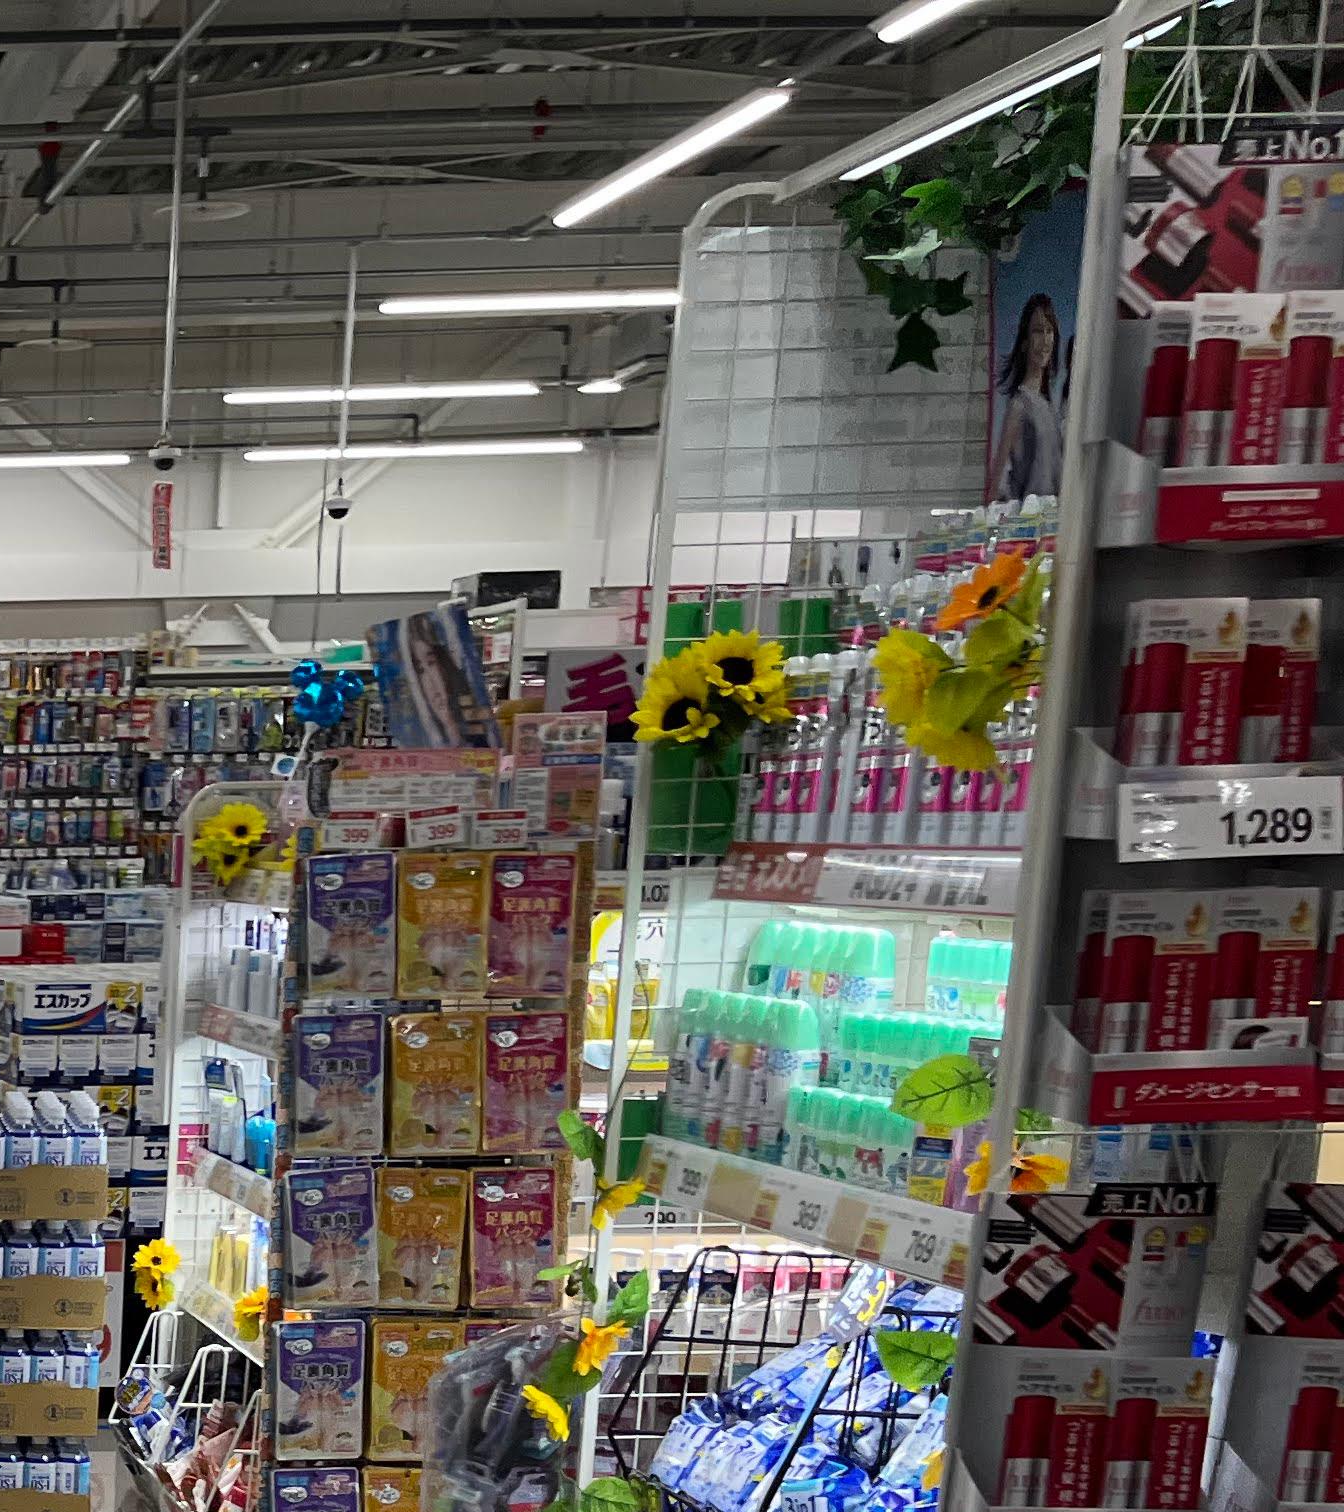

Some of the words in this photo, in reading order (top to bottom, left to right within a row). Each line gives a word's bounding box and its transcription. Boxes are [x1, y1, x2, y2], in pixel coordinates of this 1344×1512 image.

[428, 824, 457, 840] 399
[1220, 807, 1312, 847] 1,289
[340, 829, 369, 843] 399
[34, 993, 91, 1009] エスカップ
